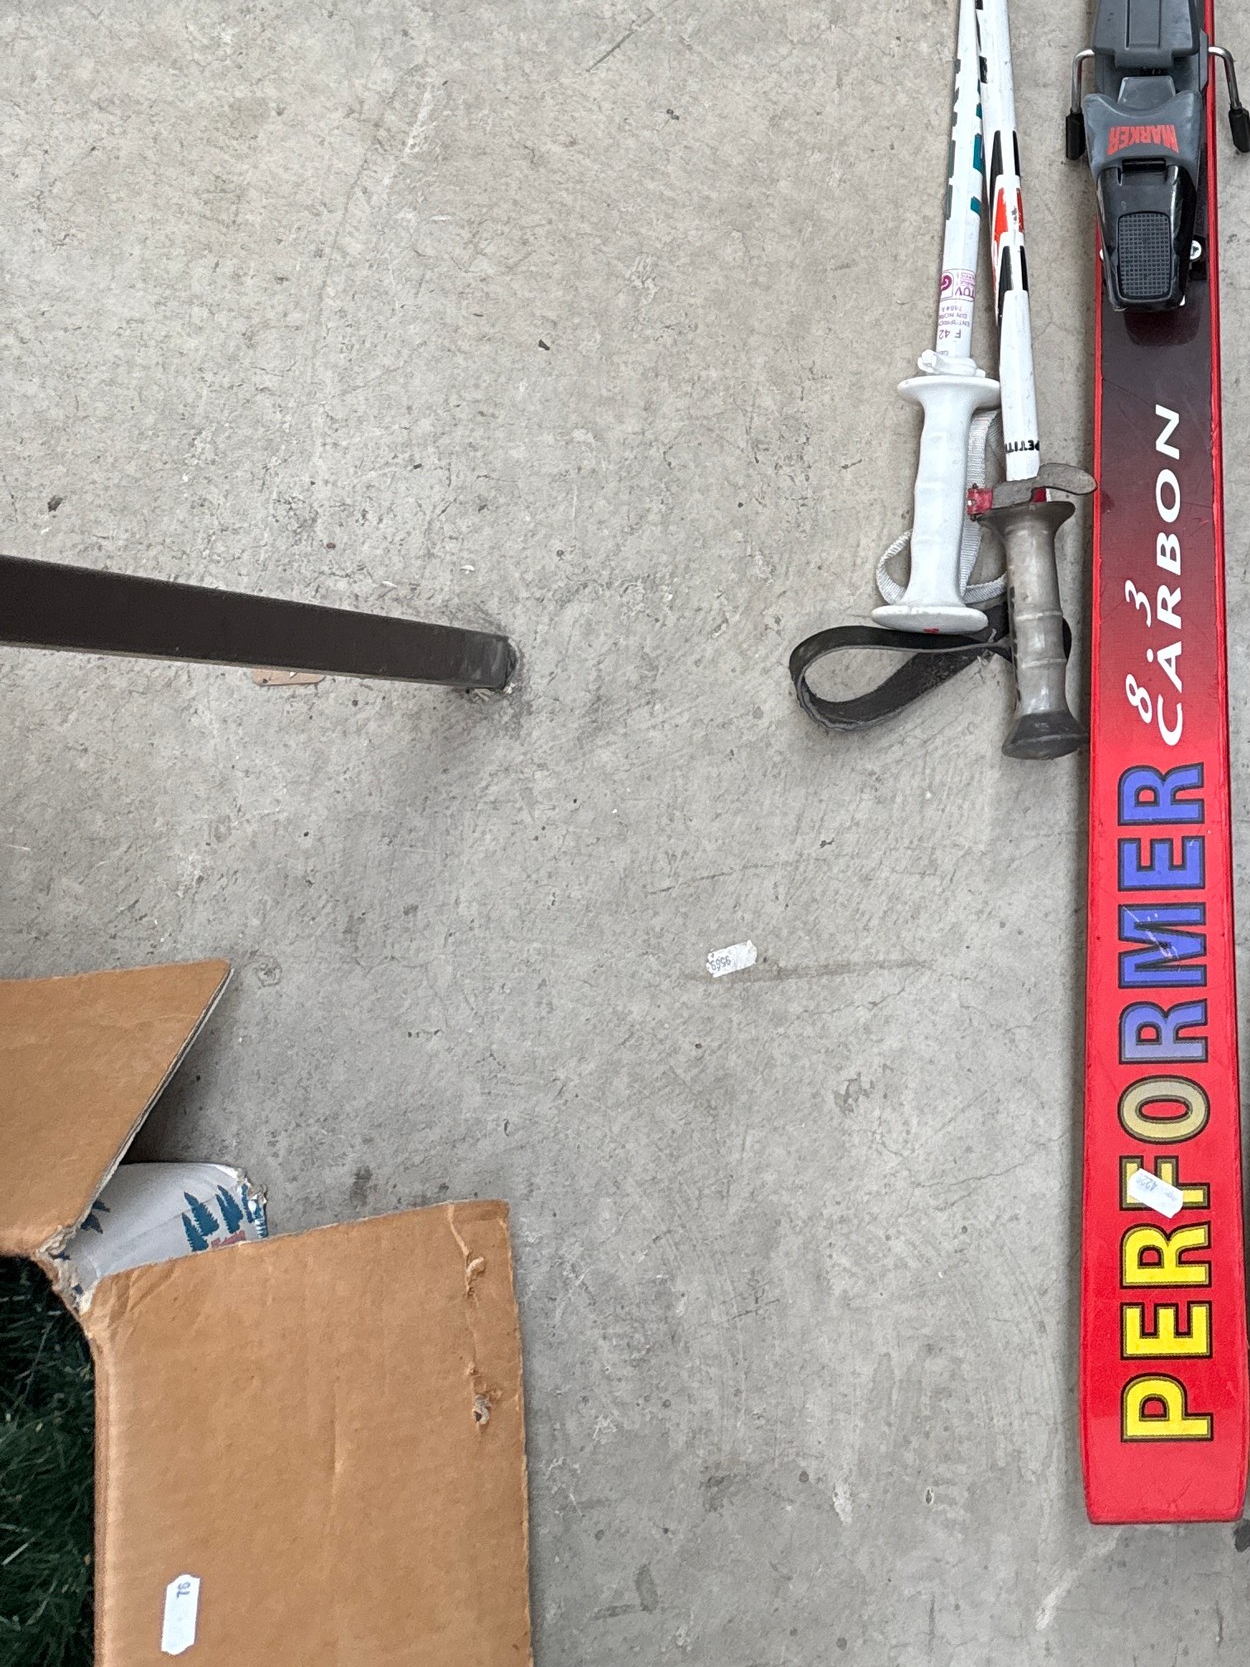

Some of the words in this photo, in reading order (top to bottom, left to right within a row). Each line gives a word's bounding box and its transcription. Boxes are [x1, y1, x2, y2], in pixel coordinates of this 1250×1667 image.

[1107, 124, 1179, 156] MARKER
[1155, 404, 1184, 746] CARBON
[1117, 762, 1214, 1444] PERFORMER
